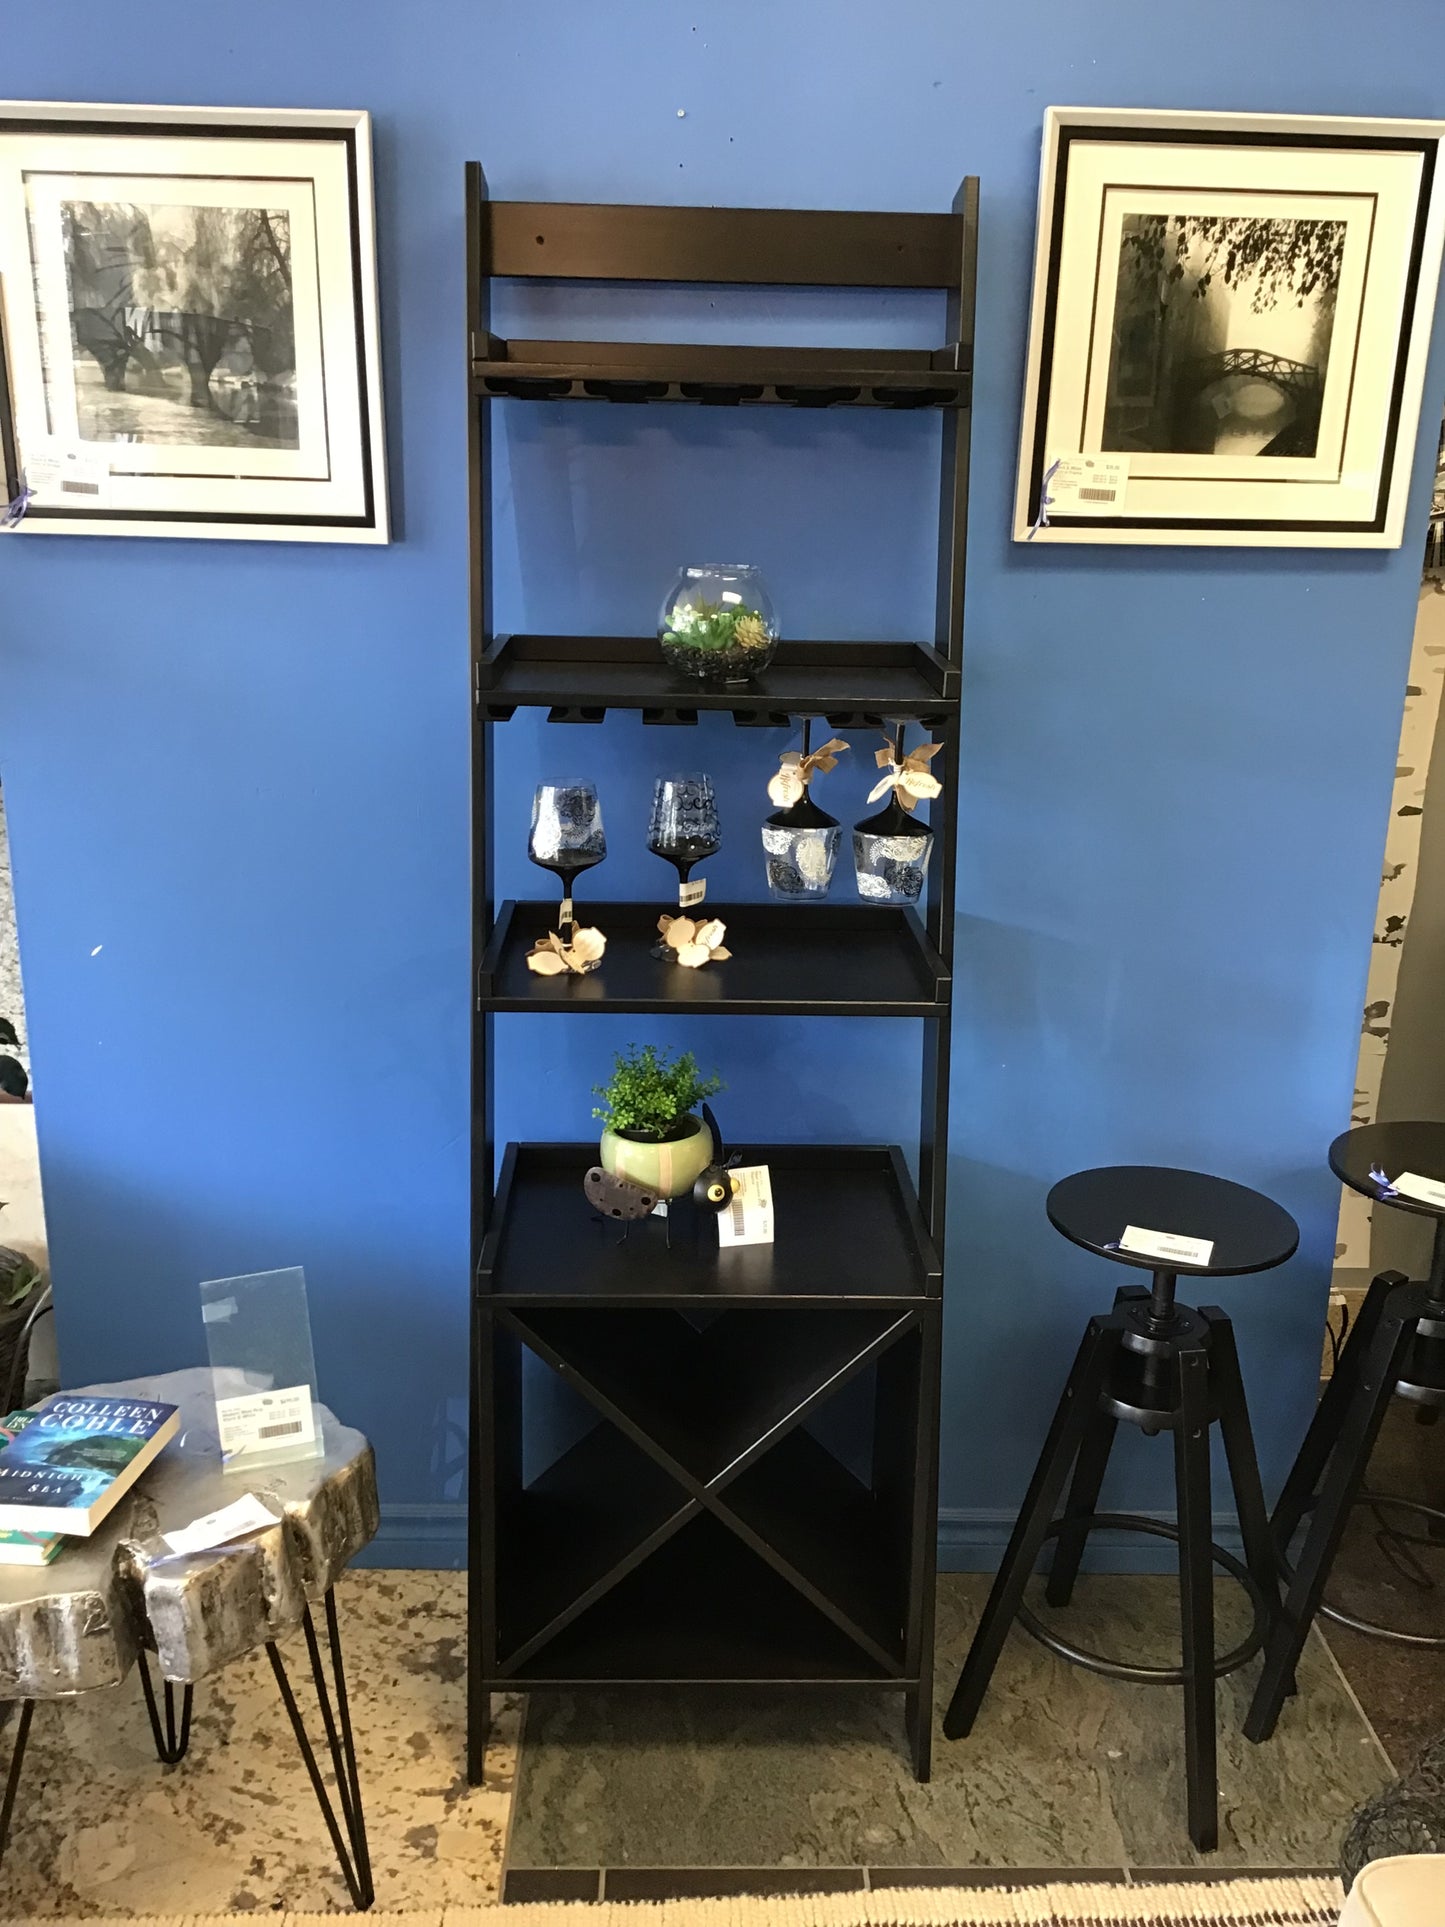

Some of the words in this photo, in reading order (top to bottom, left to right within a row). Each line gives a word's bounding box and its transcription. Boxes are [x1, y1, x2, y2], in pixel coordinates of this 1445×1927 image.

[53, 1402, 163, 1420] COLLEEN
[40, 1413, 152, 1434] COBLE
[28, 1484, 62, 1494] SEA
